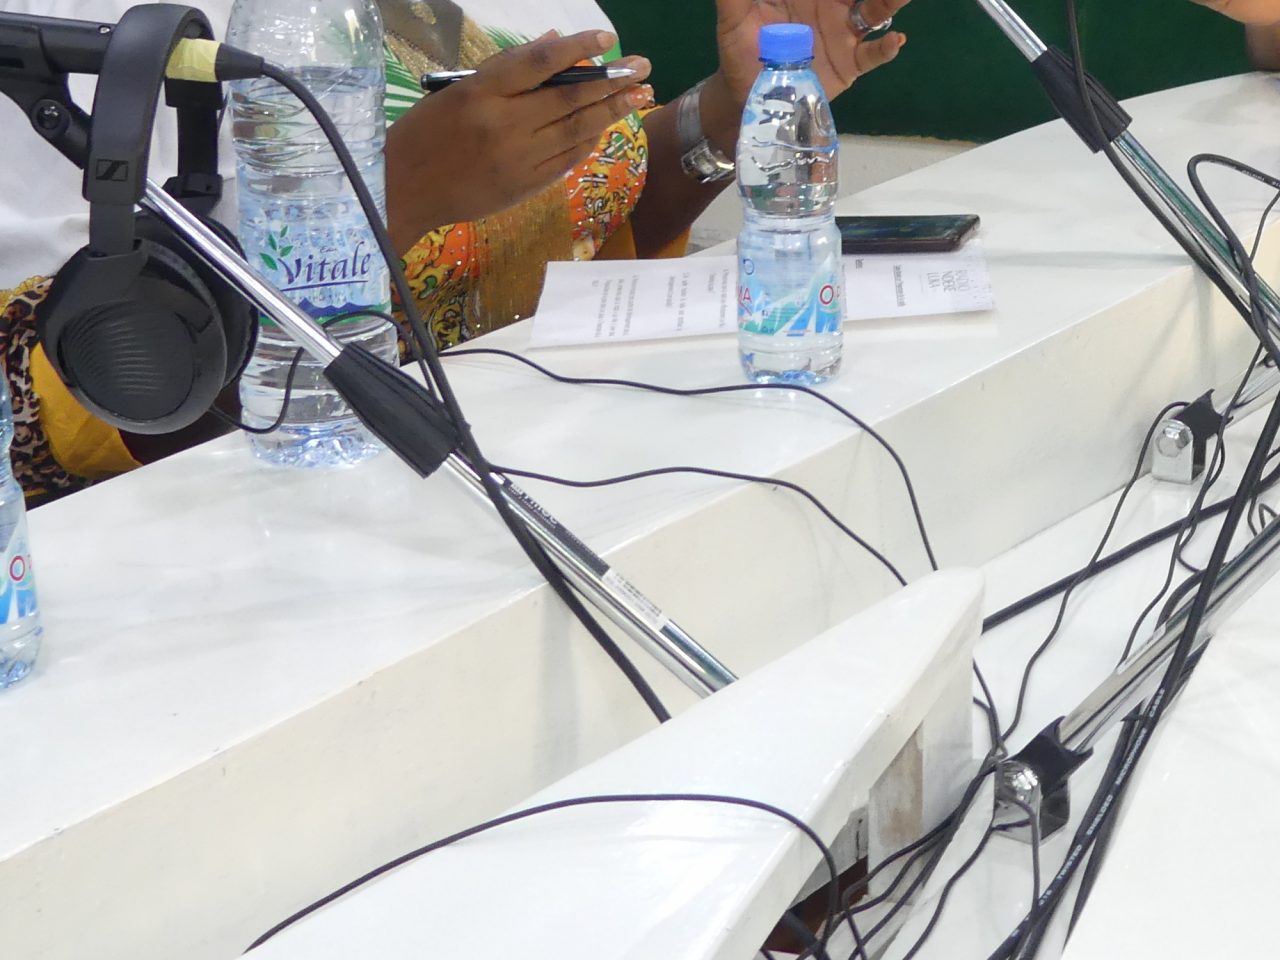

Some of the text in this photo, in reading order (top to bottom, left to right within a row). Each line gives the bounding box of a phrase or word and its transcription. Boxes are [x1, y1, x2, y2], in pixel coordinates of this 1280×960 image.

[277, 240, 372, 286] Vitale
[1056, 843, 1083, 880] TWISTED
[1086, 793, 1114, 836] SHIELDED
[1115, 726, 1148, 786] MICROPHONE
[1149, 687, 1166, 718] CABLE
